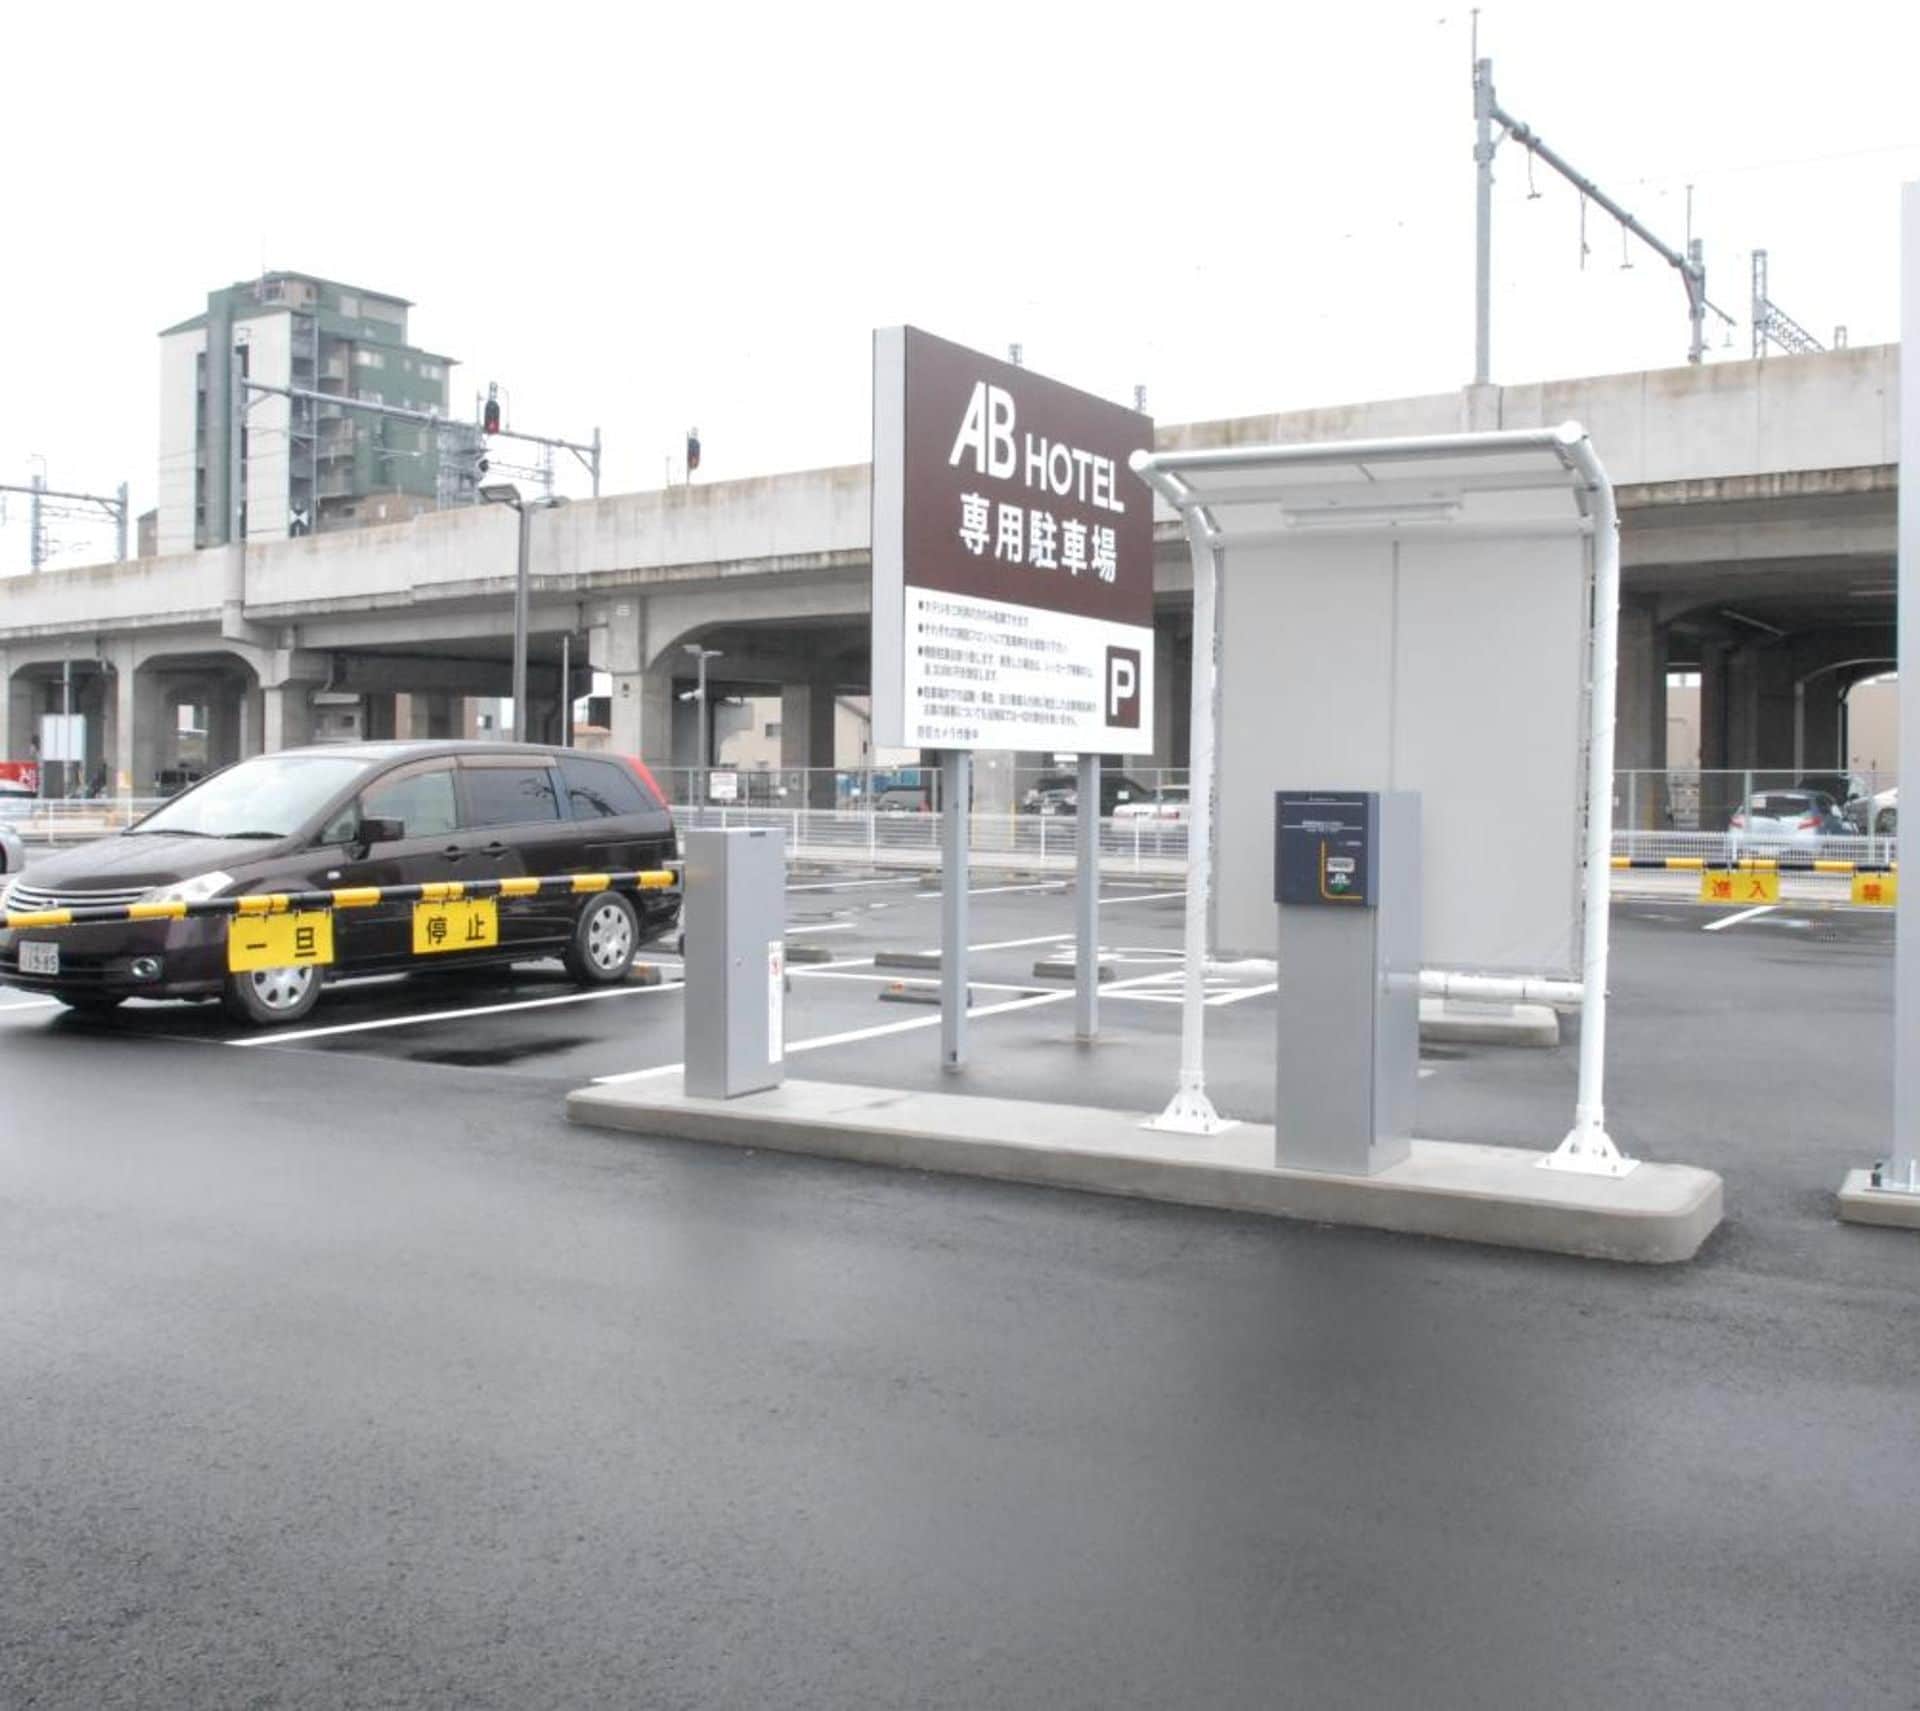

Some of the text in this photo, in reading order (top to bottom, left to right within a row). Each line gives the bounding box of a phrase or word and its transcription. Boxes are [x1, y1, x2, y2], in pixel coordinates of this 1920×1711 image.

[949, 381, 1124, 513] AB HOTEL
[959, 492, 1117, 583] 専用駐車場
[1111, 658, 1135, 717] P
[1711, 879, 1768, 899] 進入
[246, 926, 317, 957] 一旦
[427, 914, 485, 944] 停止
